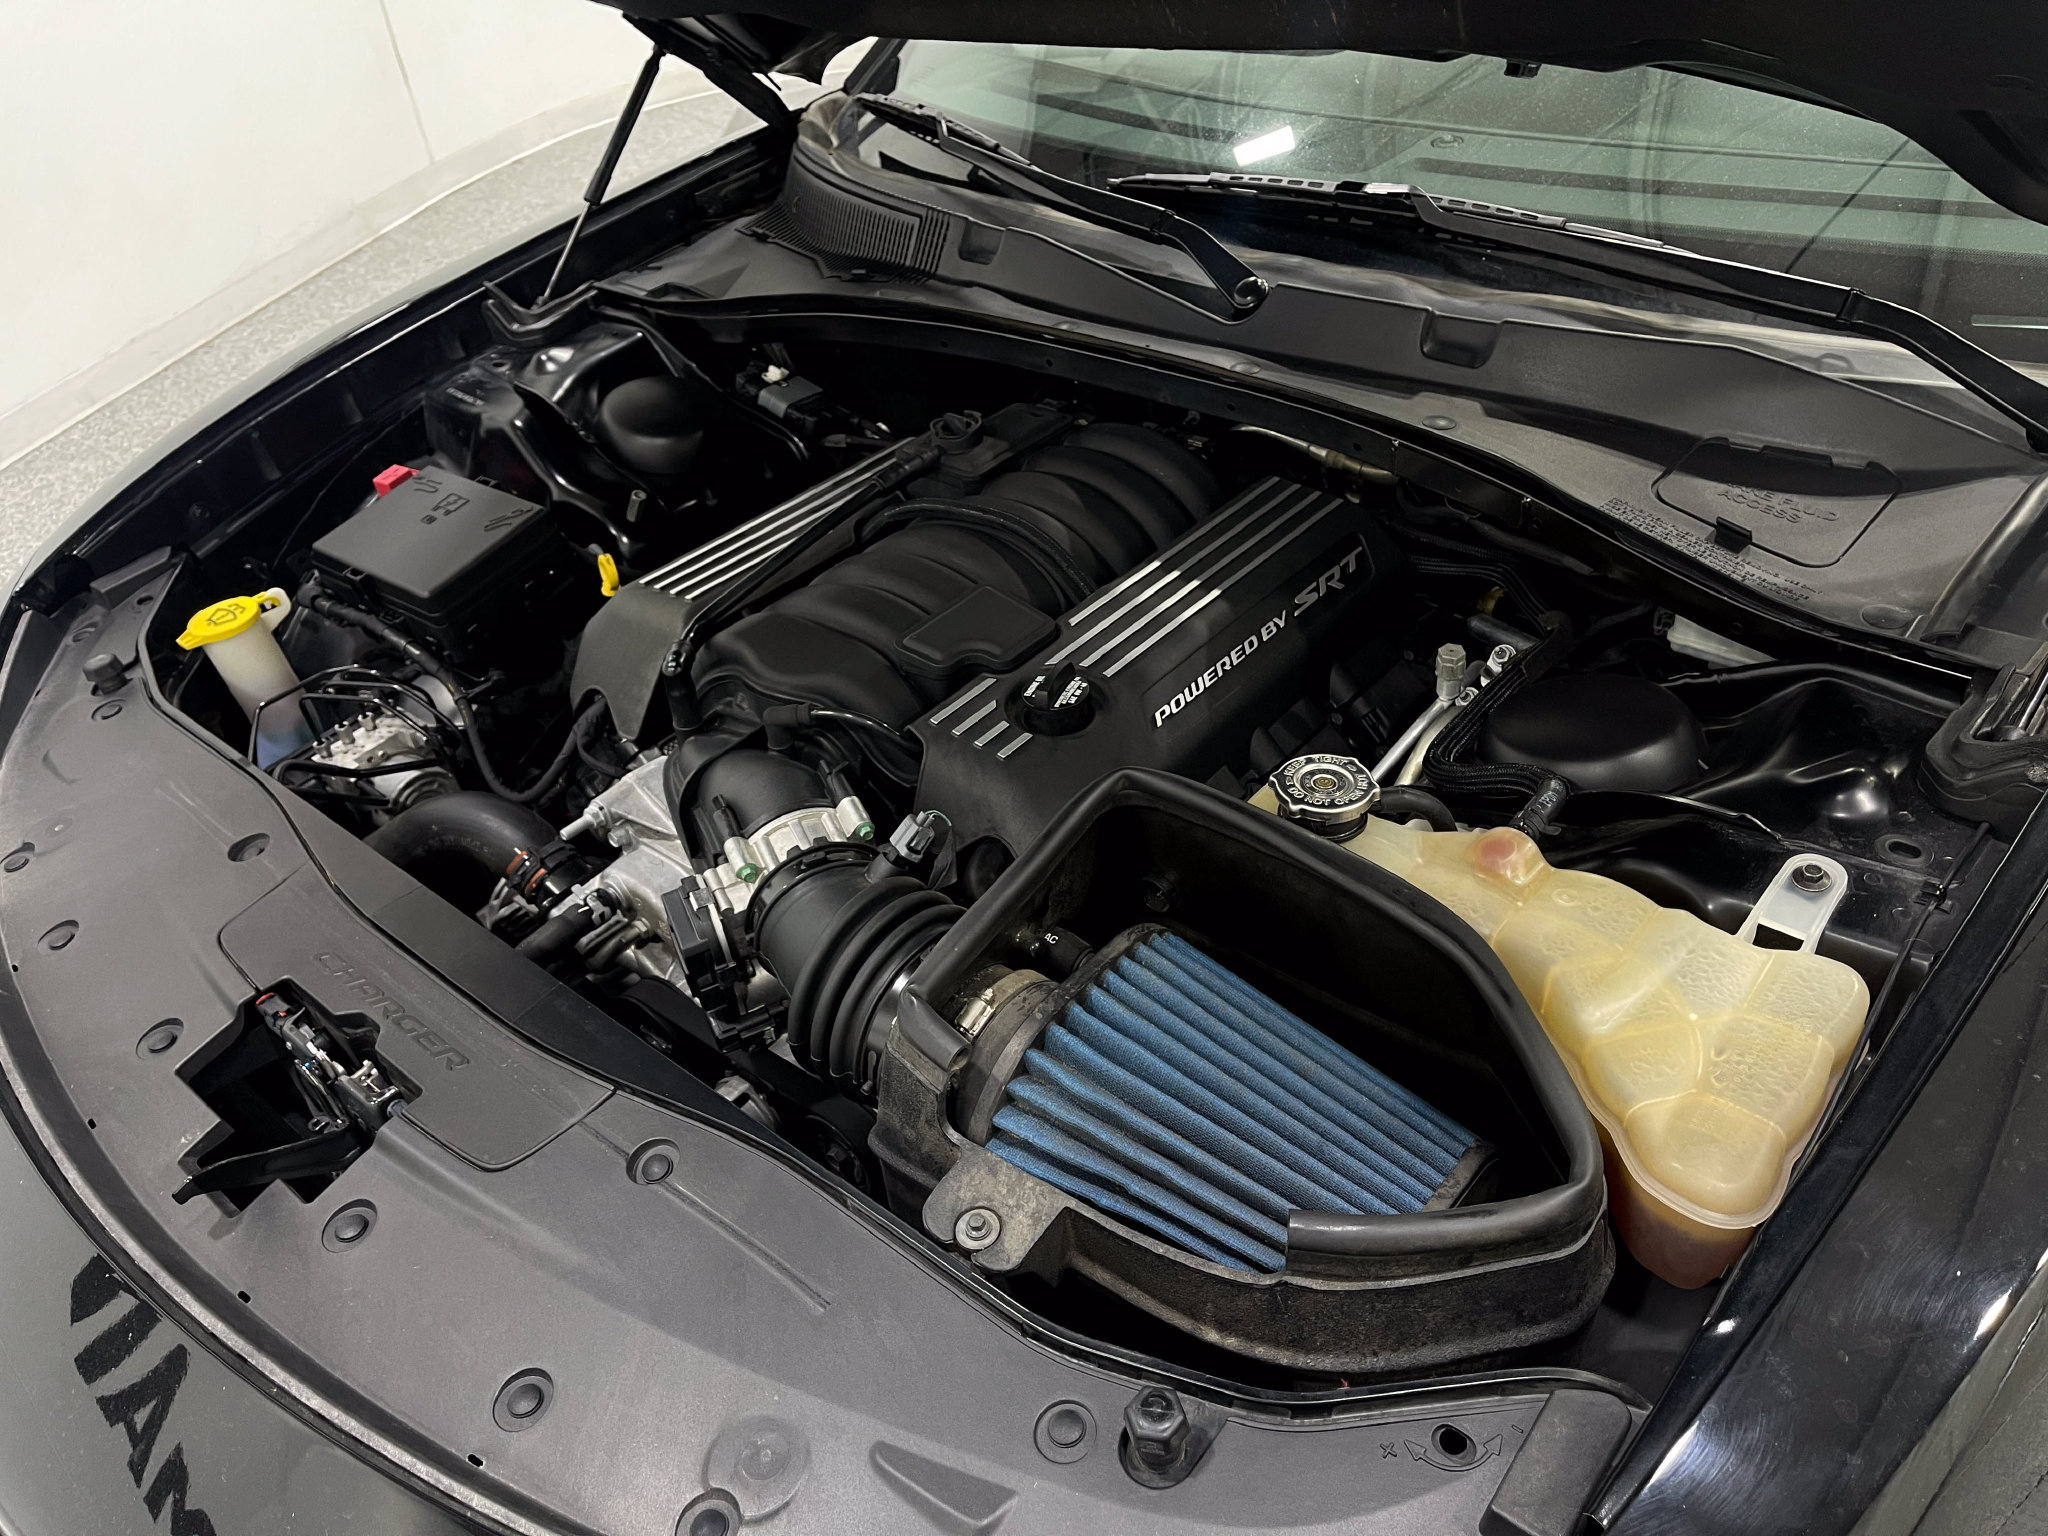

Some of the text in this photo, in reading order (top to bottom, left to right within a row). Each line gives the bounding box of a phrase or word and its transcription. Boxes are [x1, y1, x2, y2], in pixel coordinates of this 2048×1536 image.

[1717, 491, 1802, 524] ACCESS
[1154, 635, 1259, 728] POWERED
[1260, 609, 1287, 642] BY
[1294, 546, 1363, 617] SRT
[1284, 756, 1348, 776] KEEP TIGHT
[1287, 787, 1304, 798] DO
[1304, 797, 1331, 806] NOT
[1334, 790, 1364, 804] OPEN
[1357, 774, 1369, 789] HOT
[316, 953, 469, 1071] CHARGER
